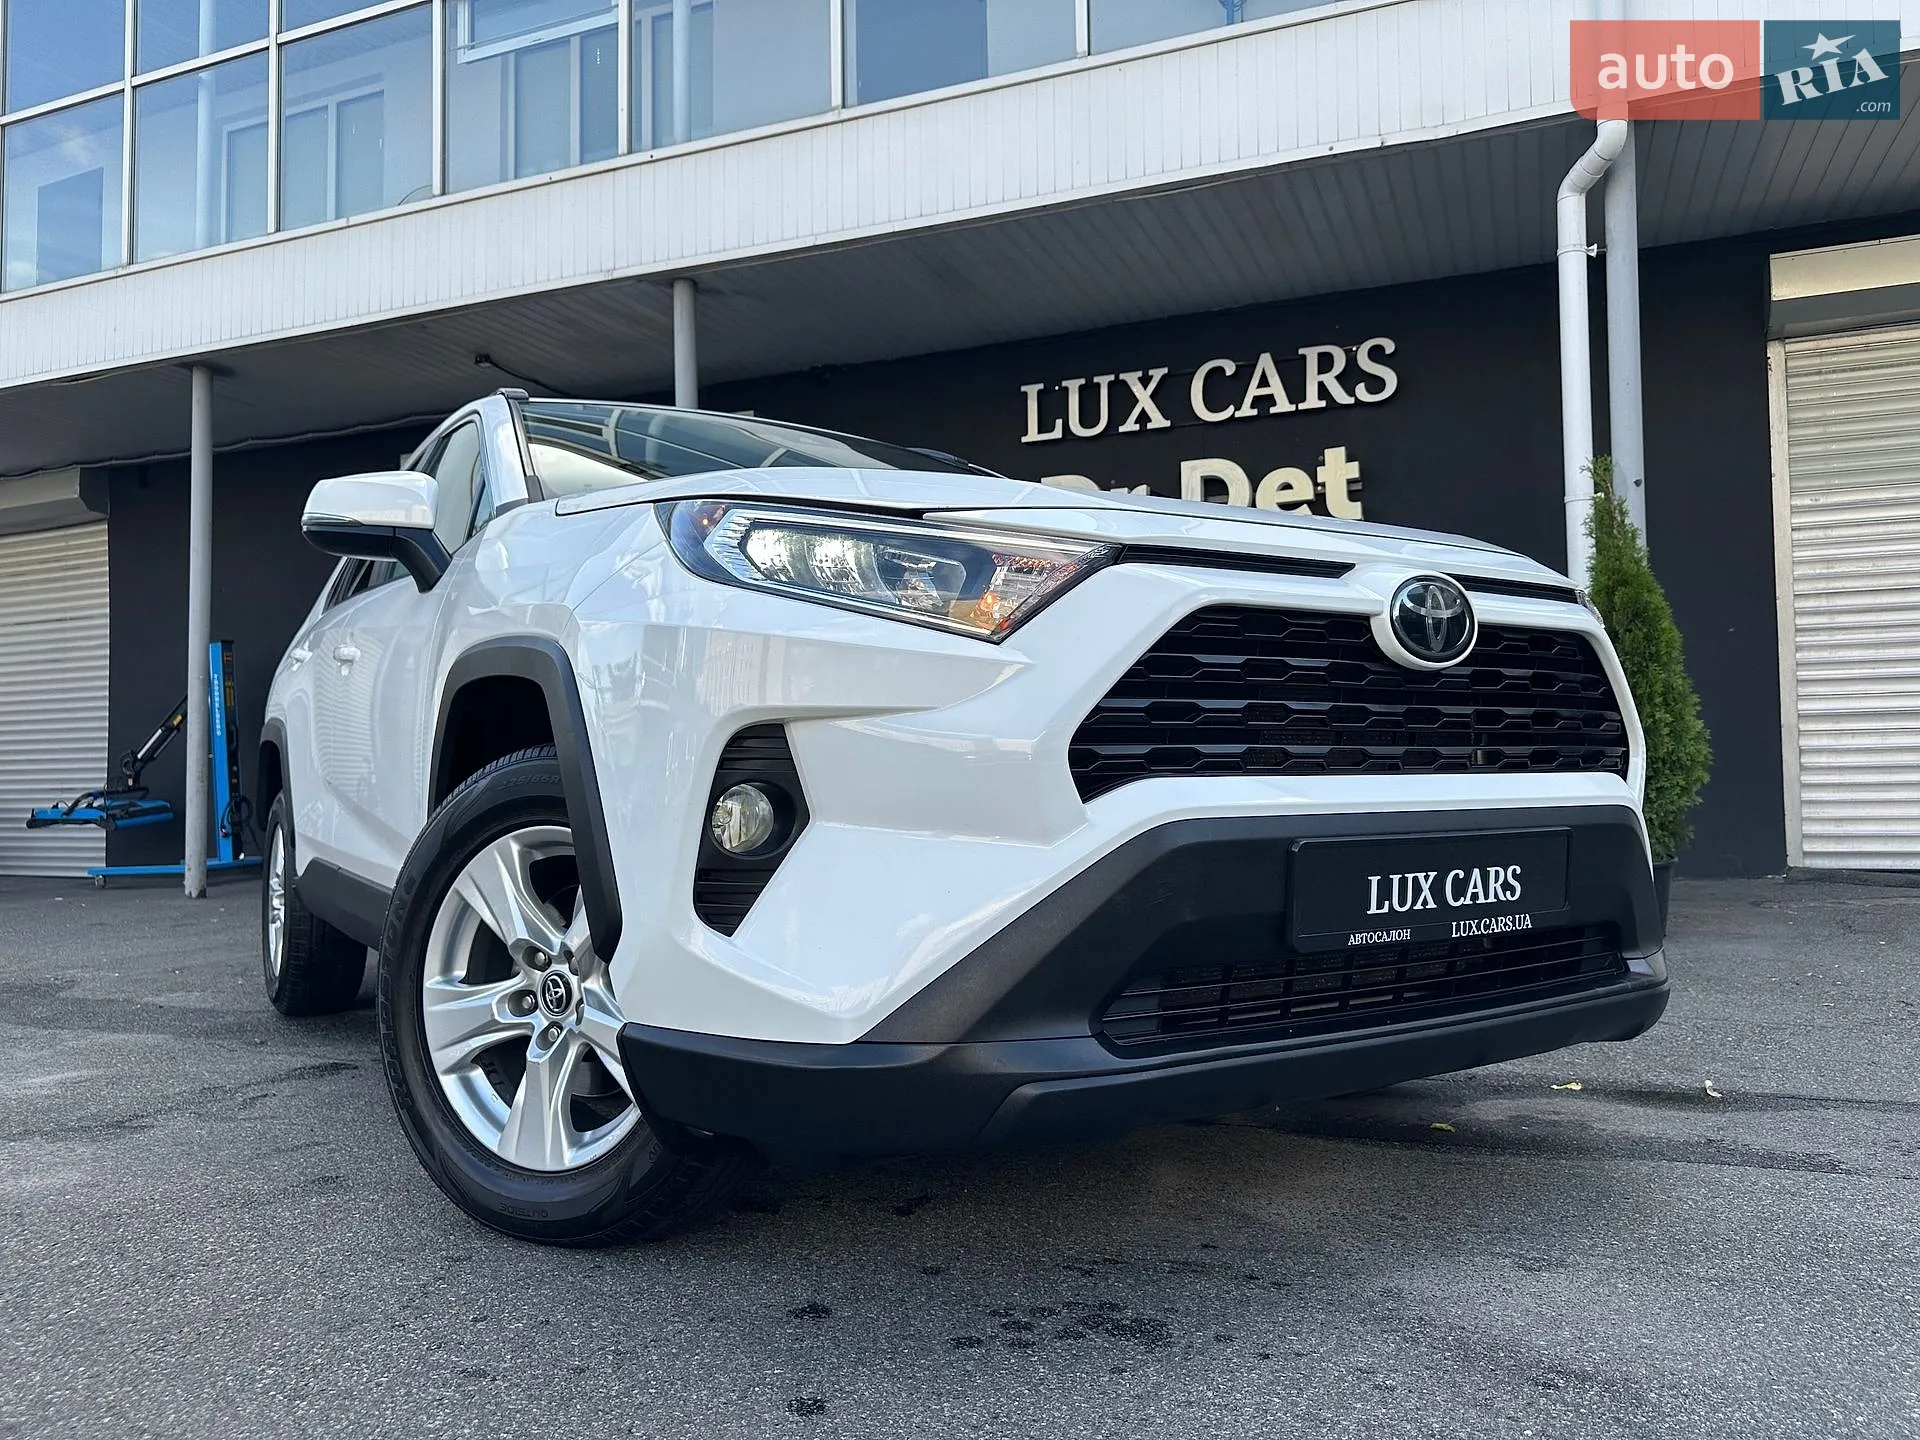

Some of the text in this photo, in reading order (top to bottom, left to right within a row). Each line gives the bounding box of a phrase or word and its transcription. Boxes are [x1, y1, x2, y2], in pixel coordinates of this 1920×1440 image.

[1020, 337, 1398, 443] LUX CARS
[1180, 446, 1363, 520] Det
[1366, 865, 1522, 915] LUX CARS
[1348, 928, 1411, 946] АВТОСАЛОН
[1451, 914, 1532, 938] LUX.CARS.UA
